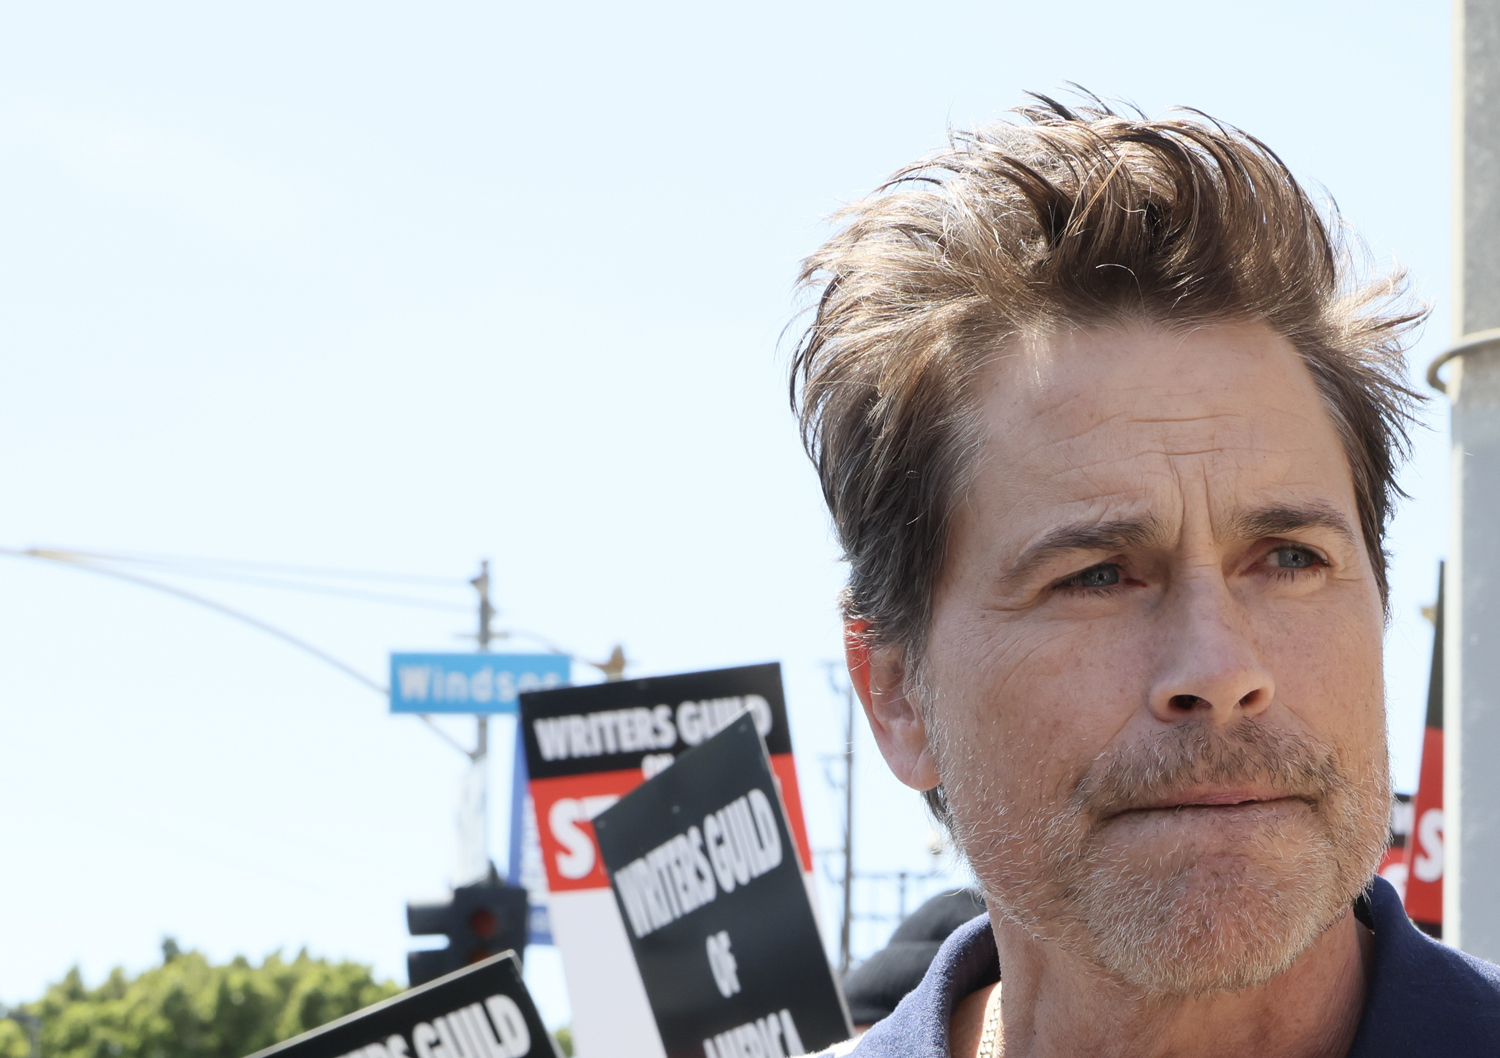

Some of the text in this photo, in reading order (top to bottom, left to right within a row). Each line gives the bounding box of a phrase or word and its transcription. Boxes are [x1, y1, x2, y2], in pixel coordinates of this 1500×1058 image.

[533, 694, 773, 761] WRITERS GUD
[613, 826, 717, 939] WRITERS
[703, 787, 783, 893] GUILD
[705, 930, 741, 998] OF
